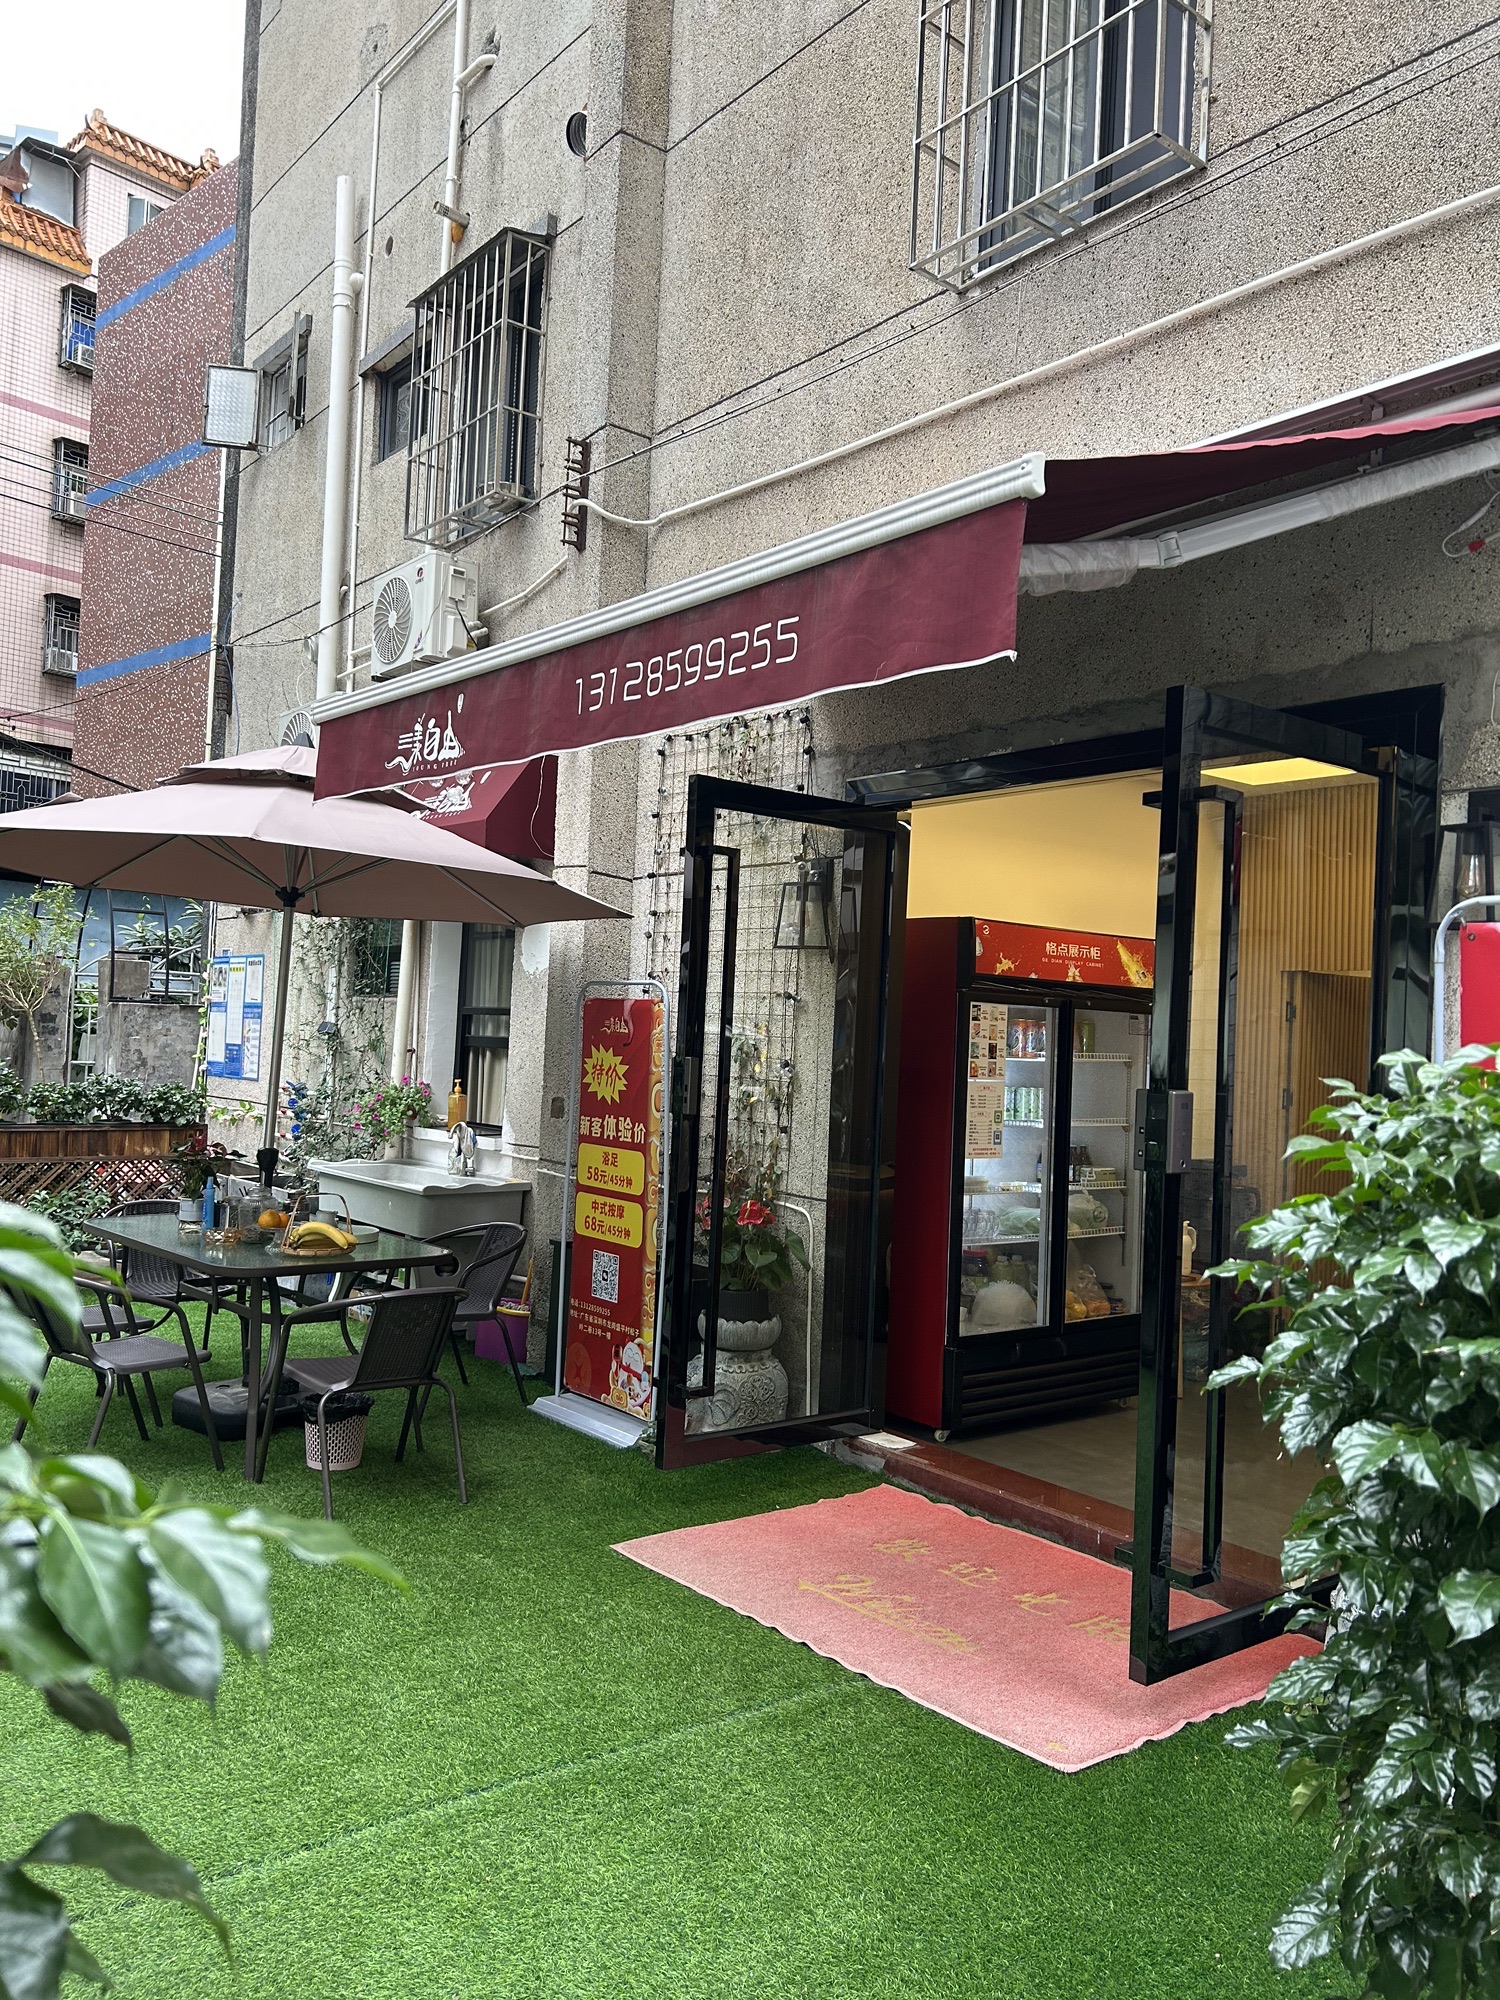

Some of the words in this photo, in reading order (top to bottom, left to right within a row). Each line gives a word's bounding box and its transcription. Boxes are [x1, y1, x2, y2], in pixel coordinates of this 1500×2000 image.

[576, 616, 799, 714] 13128599255
[1045, 941, 1101, 960] 格点展示柜
[1085, 961, 1104, 969] CABINET
[591, 1057, 622, 1095] 特价
[580, 1114, 646, 1144] 新客体验价
[602, 1151, 619, 1168] 浴足
[586, 1165, 633, 1190] 58元/45分钟
[591, 1199, 625, 1220] 中式按摩
[584, 1215, 631, 1240] 68元/45分钟
